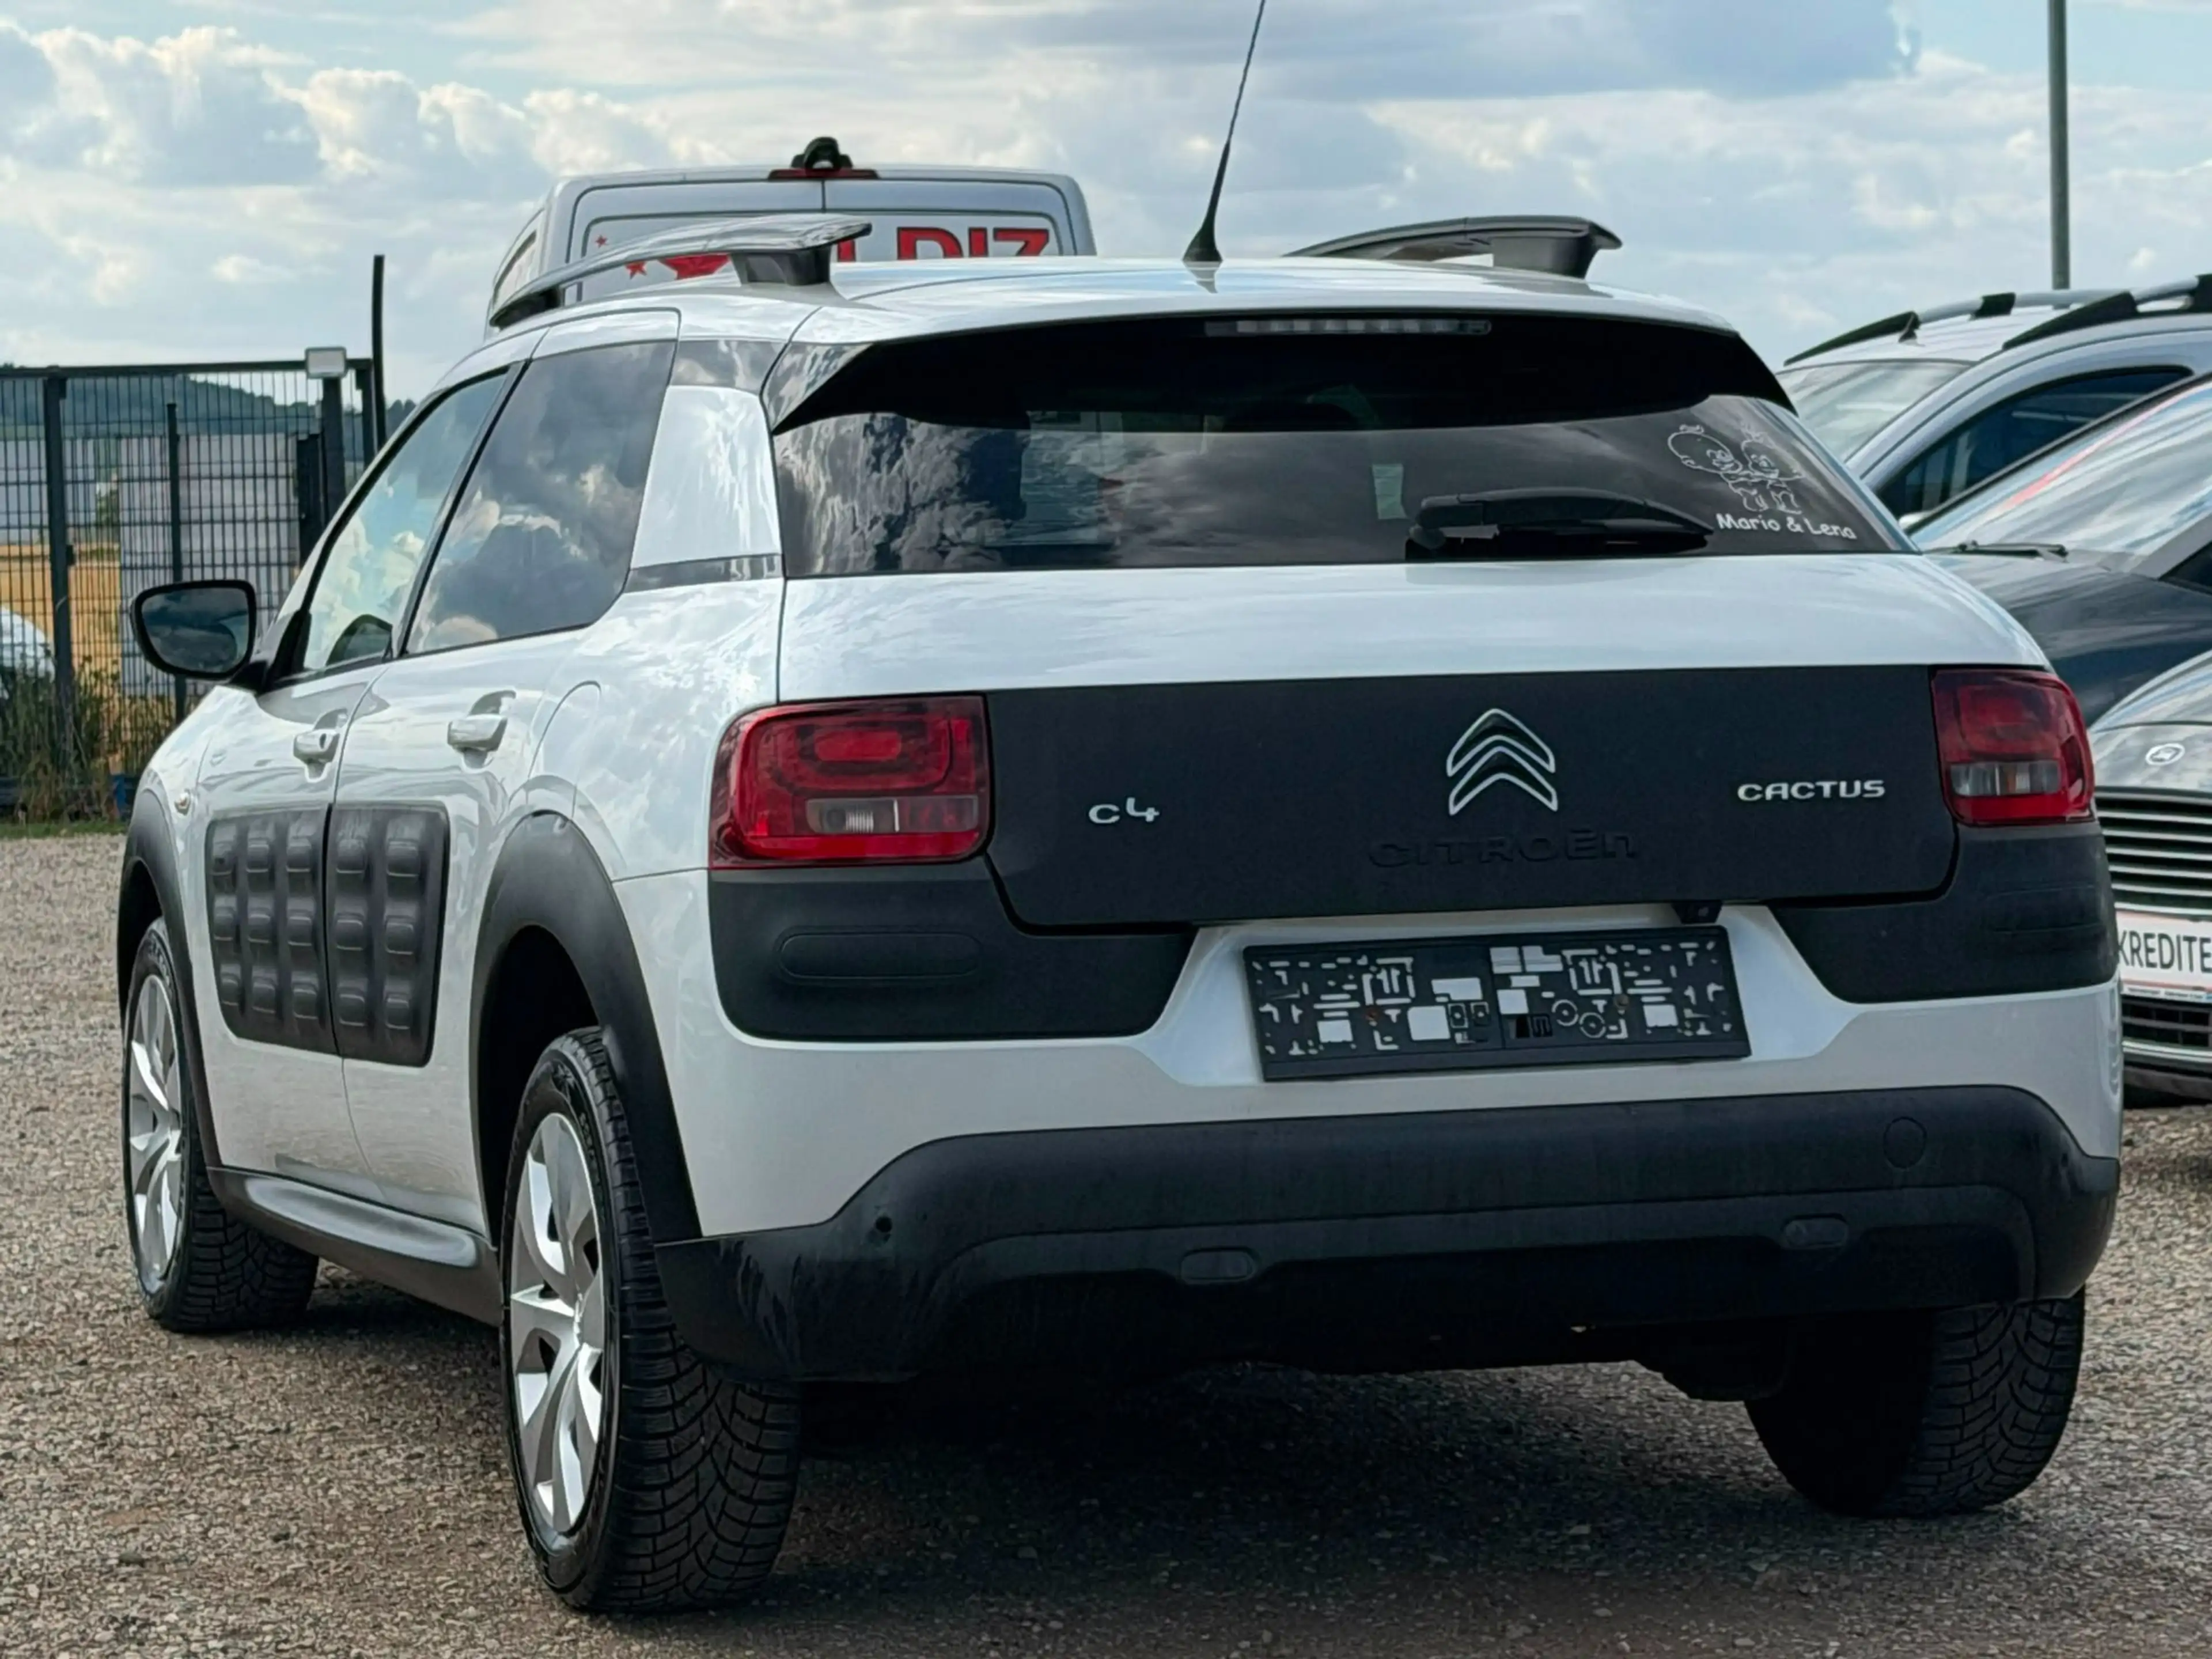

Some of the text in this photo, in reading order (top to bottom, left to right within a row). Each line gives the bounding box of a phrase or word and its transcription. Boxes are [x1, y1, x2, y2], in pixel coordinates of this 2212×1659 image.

[1715, 513, 1857, 540] Mario & Lena
[1737, 779, 1885, 801] CACTUS
